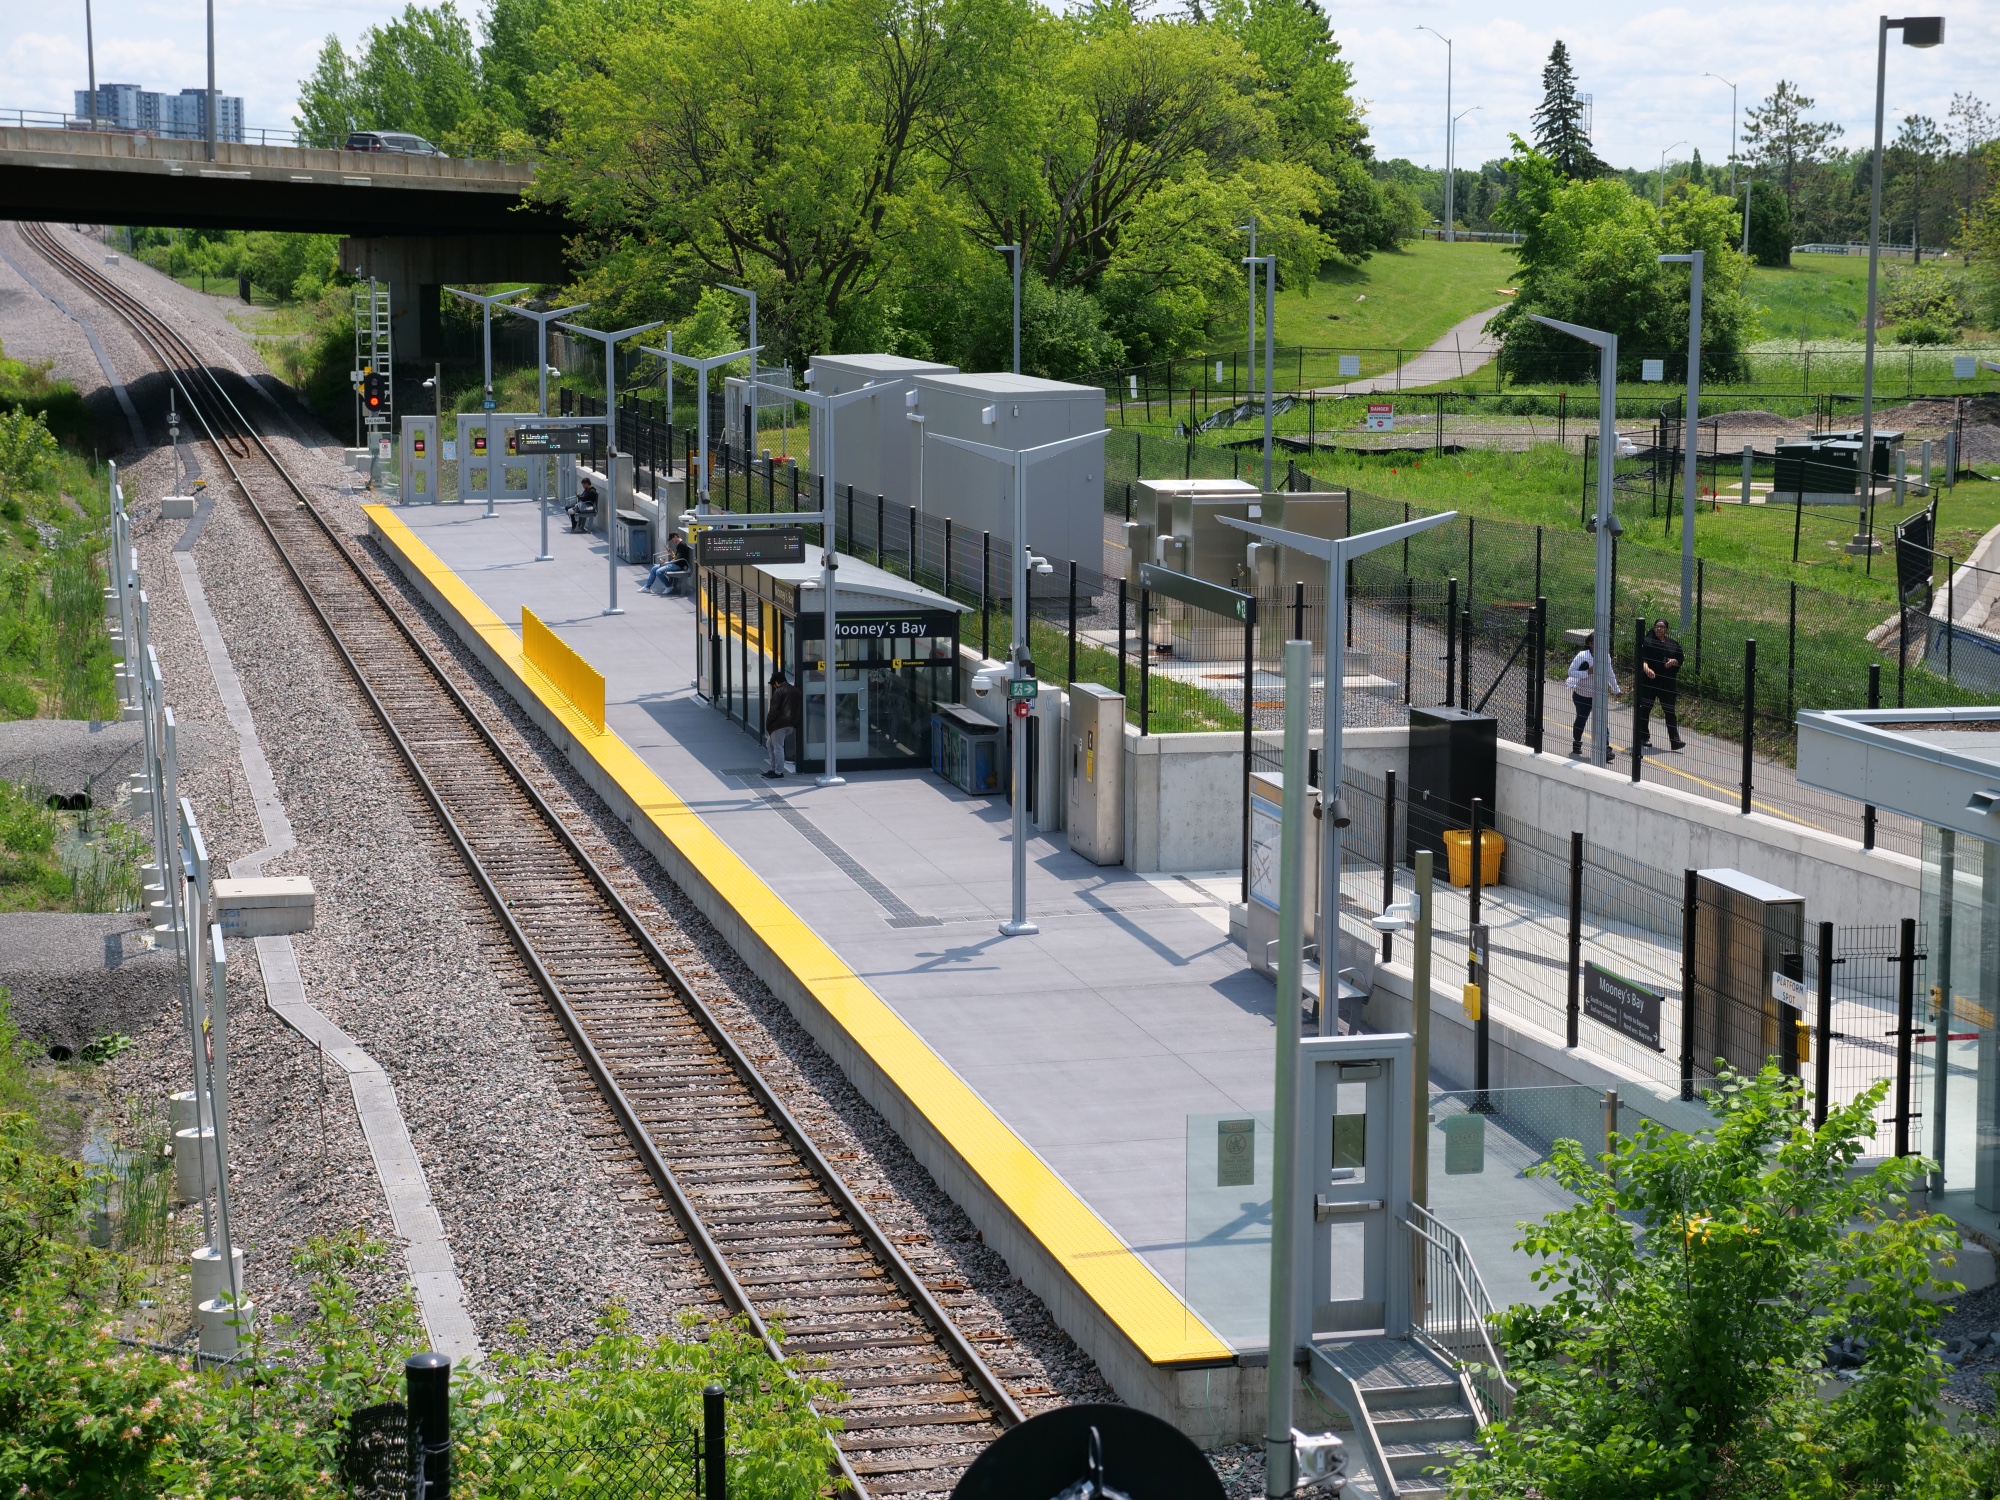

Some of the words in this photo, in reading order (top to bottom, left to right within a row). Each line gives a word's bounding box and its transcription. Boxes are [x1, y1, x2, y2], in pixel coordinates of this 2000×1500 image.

[902, 622, 926, 636] Bay
[1777, 975, 1803, 995] PLATFORM
[1600, 977, 1630, 1004] Mooney's
[1632, 993, 1644, 1013] Bay
[1783, 992, 1795, 1004] SPOT
[1603, 1002, 1617, 1014] Limebank
[1603, 1011, 1616, 1023] Limebank
[1623, 1012, 1632, 1022] North
[1637, 1019, 1649, 1030] Bayview
[1639, 1030, 1652, 1042] Bayview
